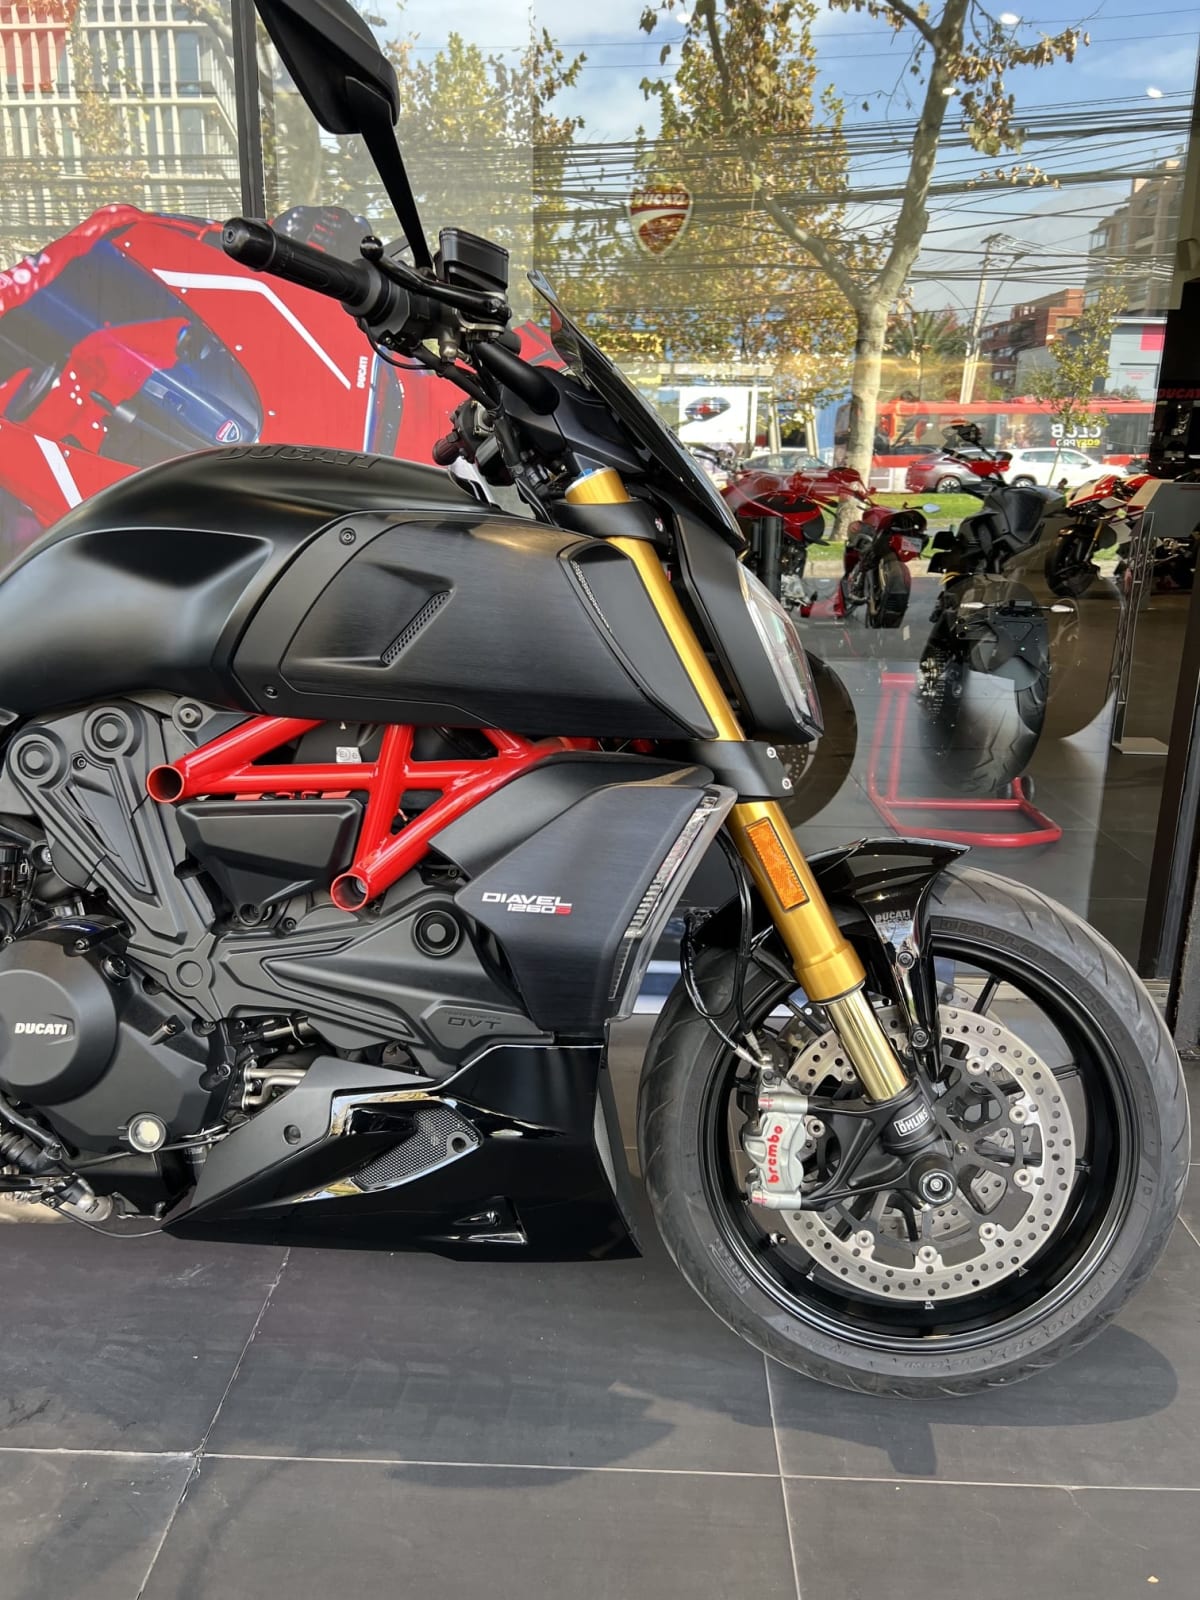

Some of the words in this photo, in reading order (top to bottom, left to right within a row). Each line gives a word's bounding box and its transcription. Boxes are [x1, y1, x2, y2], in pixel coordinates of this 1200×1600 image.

[216, 445, 381, 469] DUCATI
[482, 892, 573, 907] DIAVEL
[875, 910, 911, 923] DUCATI
[939, 917, 1042, 961] DIABLO
[14, 1022, 68, 1035] DUCATI
[448, 1016, 502, 1030] DVT
[898, 1108, 929, 1133] ÖHLINS
[767, 1125, 784, 1184] brembo
